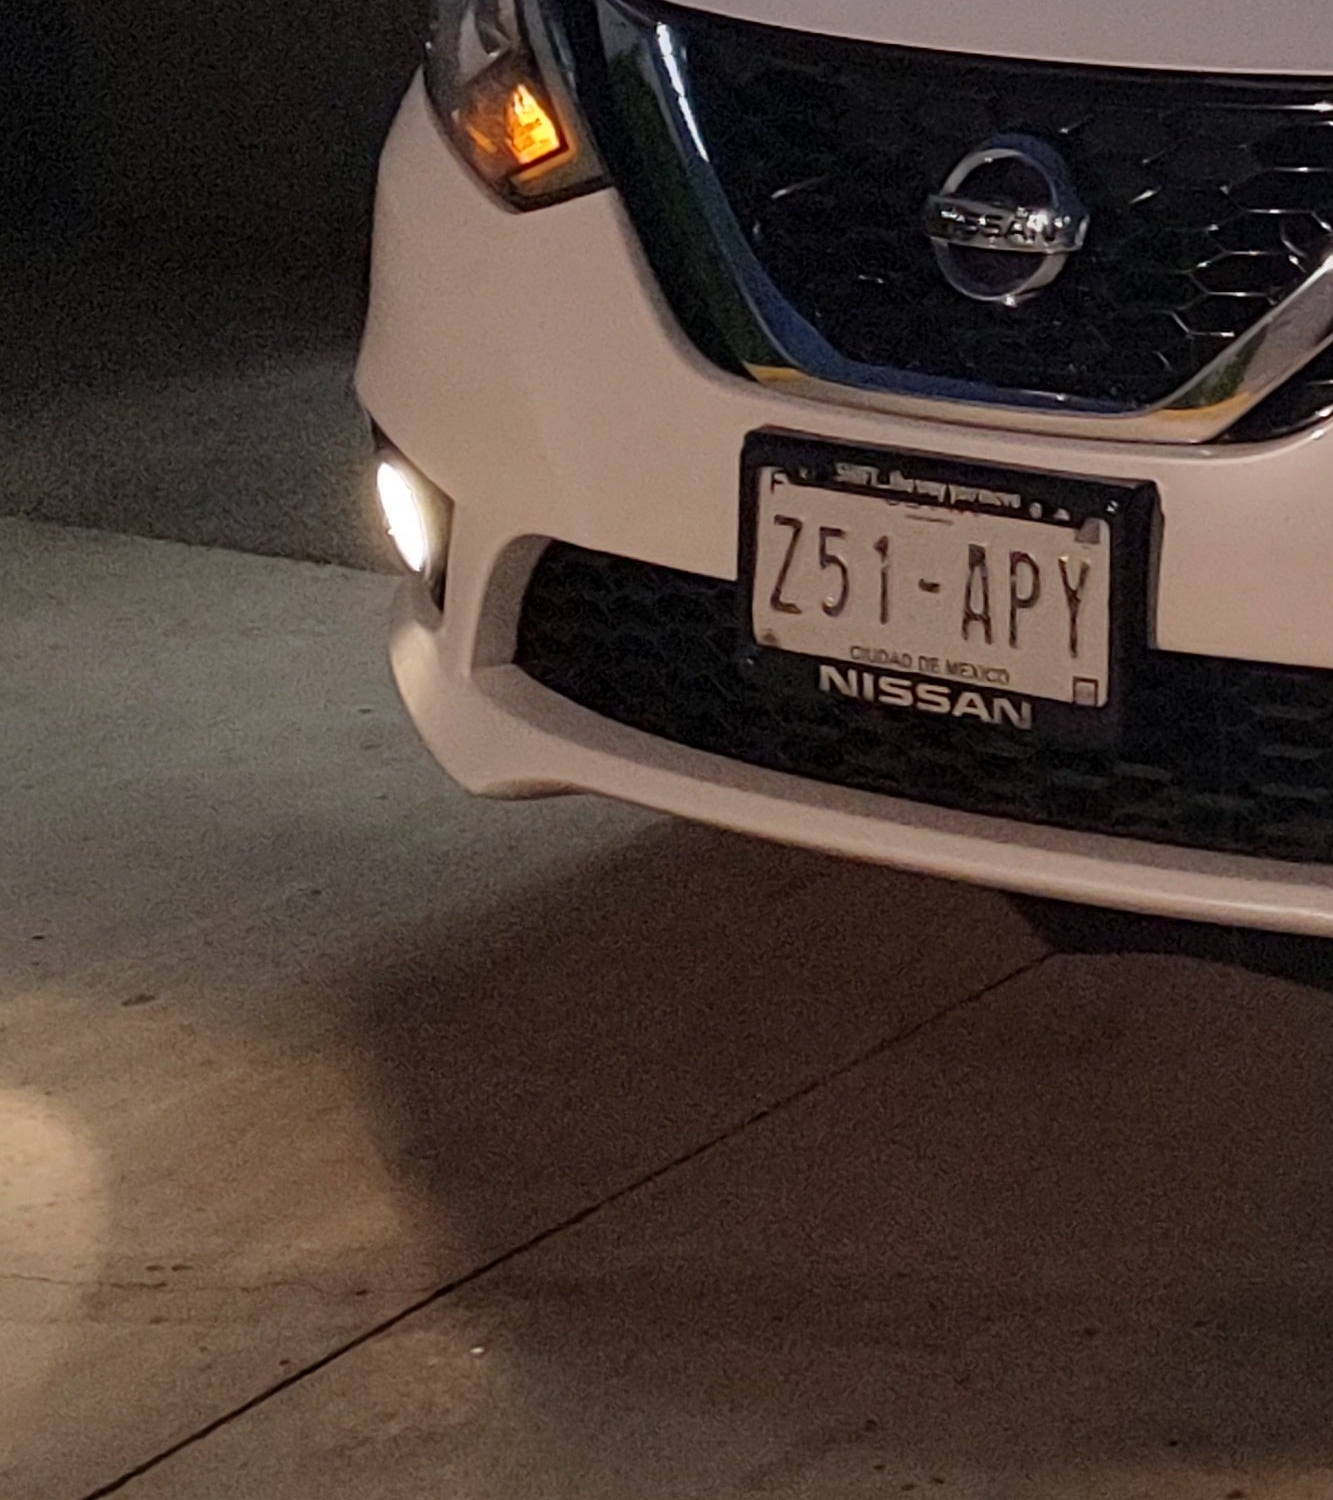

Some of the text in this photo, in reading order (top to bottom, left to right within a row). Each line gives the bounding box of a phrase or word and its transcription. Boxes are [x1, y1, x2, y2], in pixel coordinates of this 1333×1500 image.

[769, 514, 1091, 659] Z51-APY
[850, 645, 913, 669] CIUDAD
[917, 655, 940, 673] DE
[818, 663, 1033, 730] NISSAN
